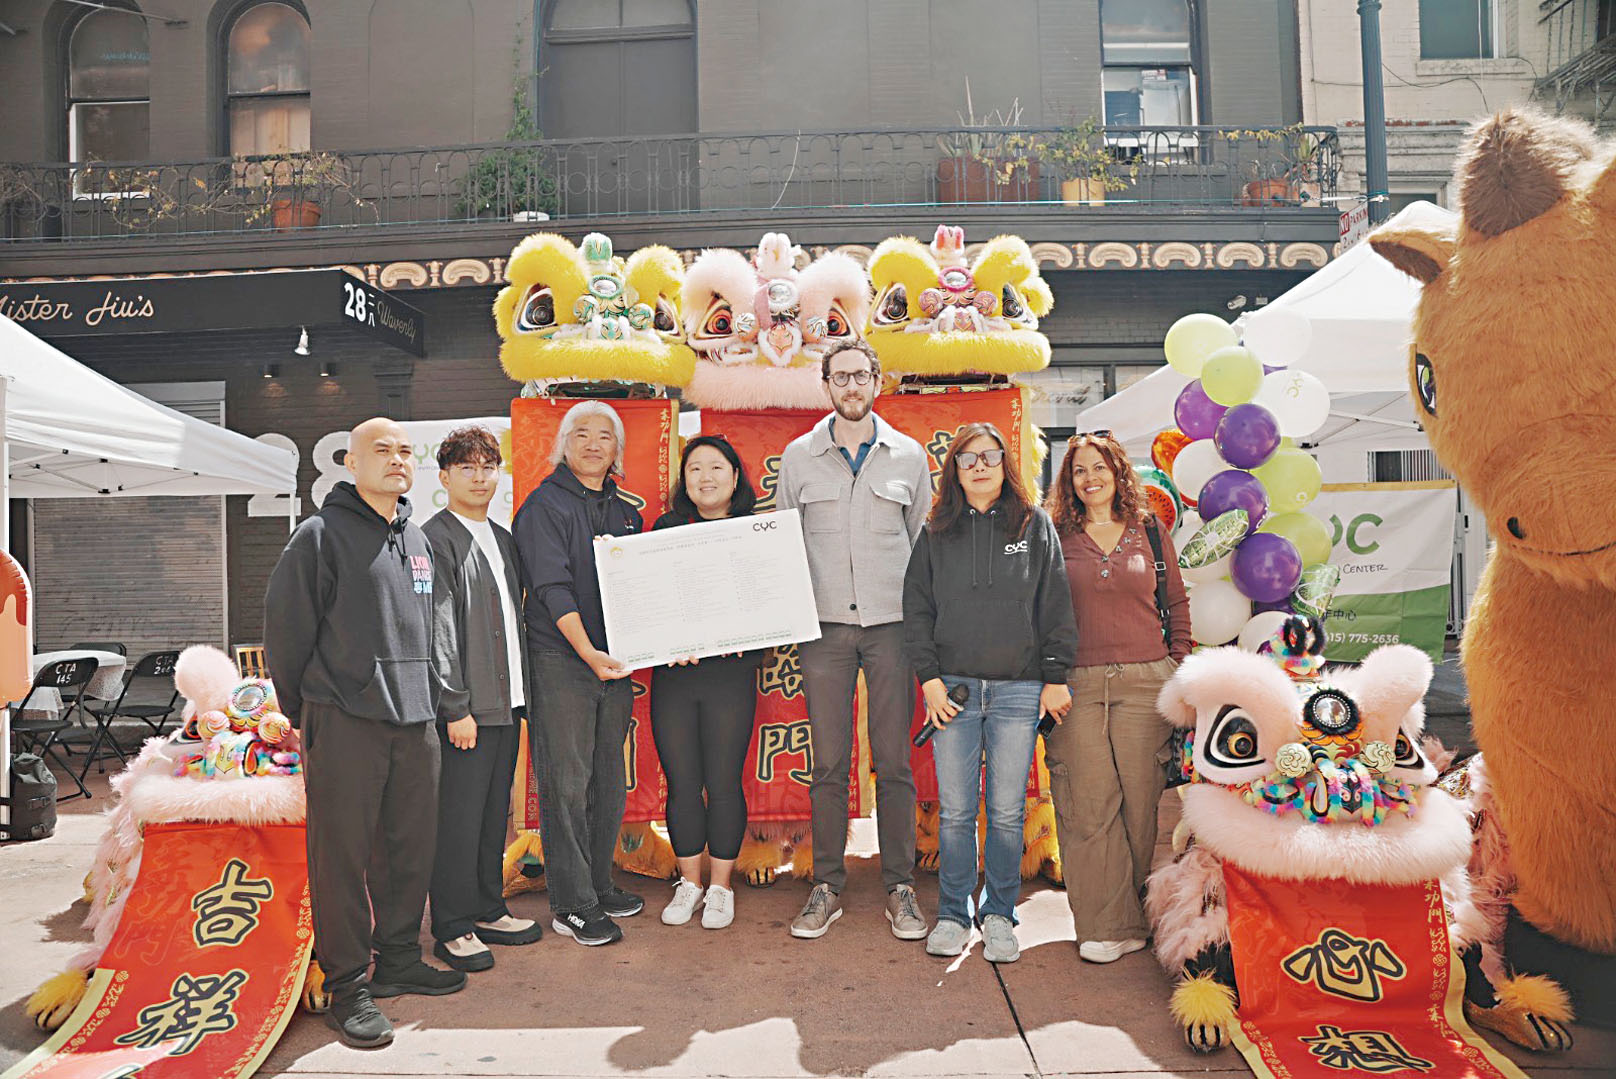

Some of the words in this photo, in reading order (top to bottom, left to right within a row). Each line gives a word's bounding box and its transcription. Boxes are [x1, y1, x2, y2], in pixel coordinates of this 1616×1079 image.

[1350, 207, 1368, 224] PARKIN
[85, 290, 154, 326] Jiu's
[344, 282, 366, 322] 28
[377, 301, 416, 344] Waverly
[752, 520, 778, 532] CYC
[1348, 632, 1400, 644] 775-2636
[55, 662, 77, 675] CTA
[56, 673, 73, 685] 145
[101, 857, 275, 1079] 吉祥
